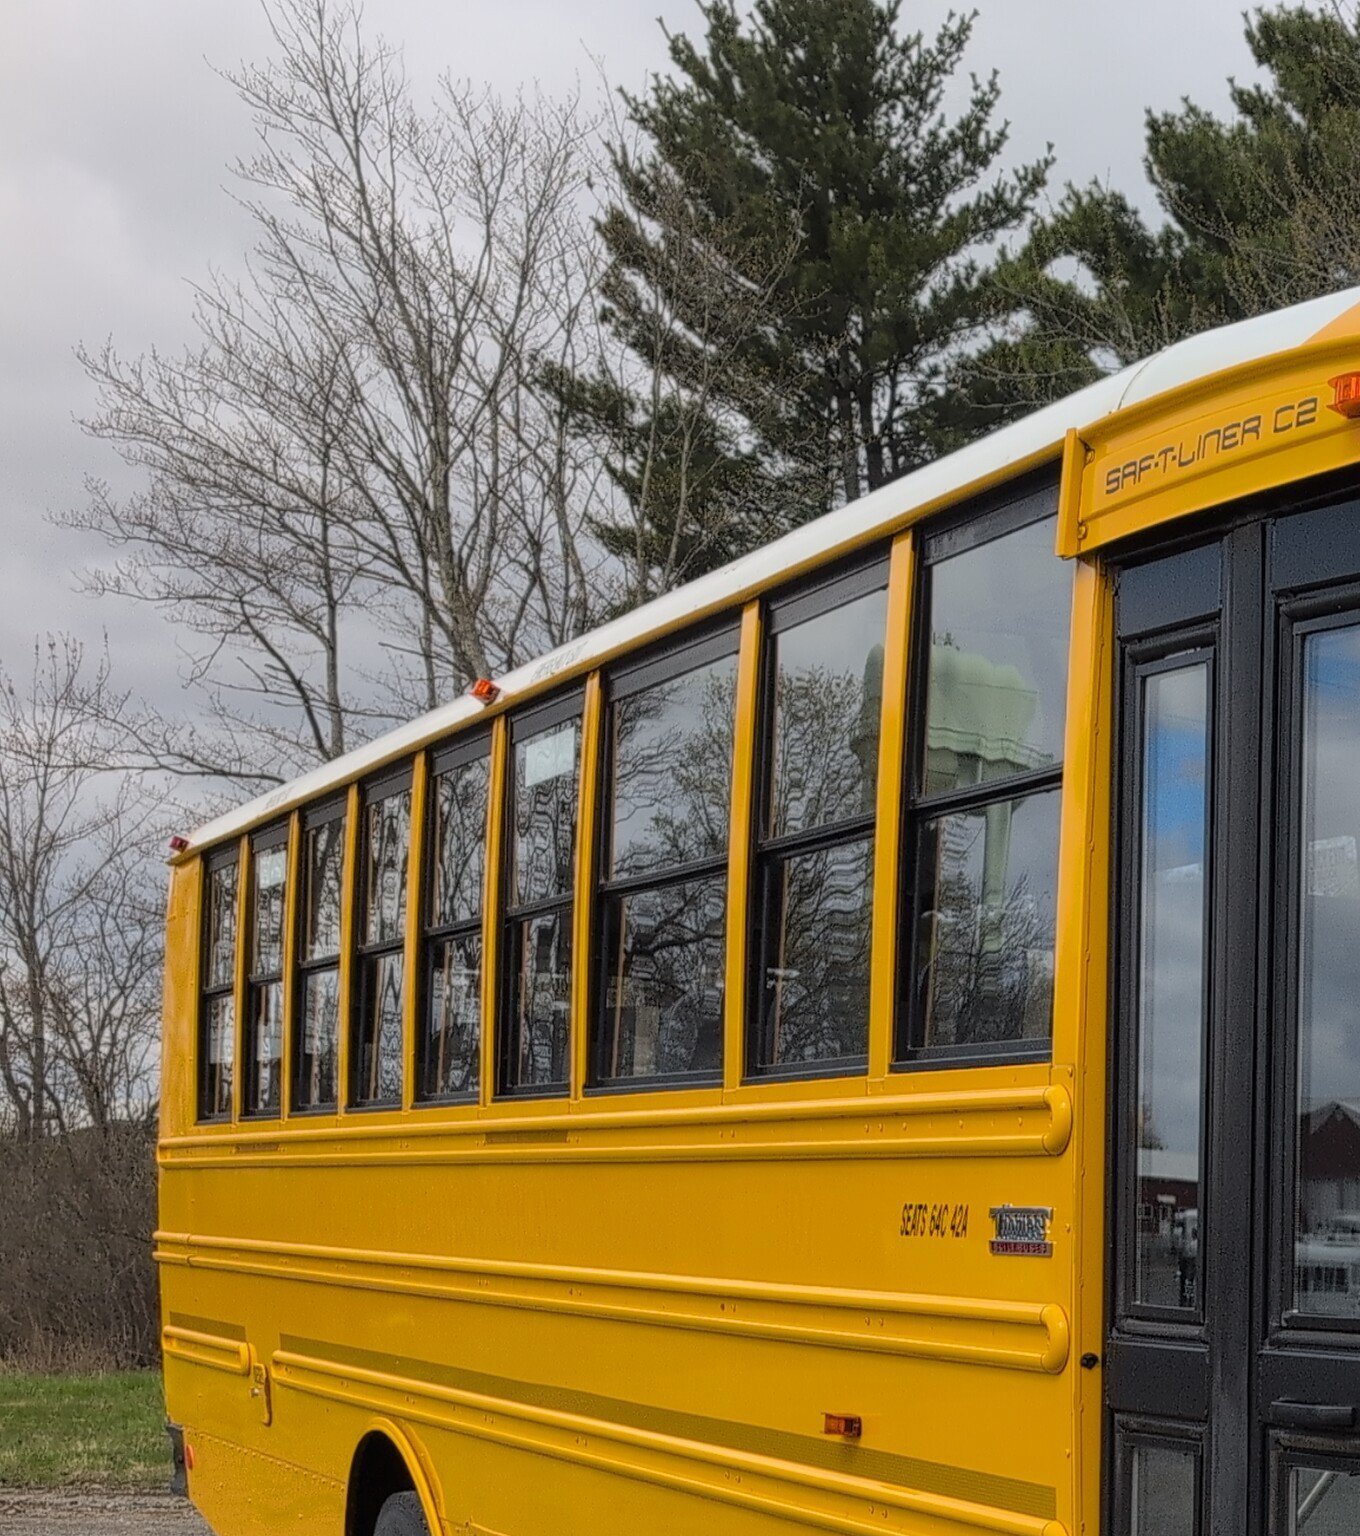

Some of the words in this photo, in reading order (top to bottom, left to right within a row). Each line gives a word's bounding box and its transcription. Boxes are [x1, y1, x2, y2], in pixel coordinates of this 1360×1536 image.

[1272, 396, 1319, 434] C2
[899, 1202, 928, 1237] SEATS
[950, 1203, 970, 1239] 42A
